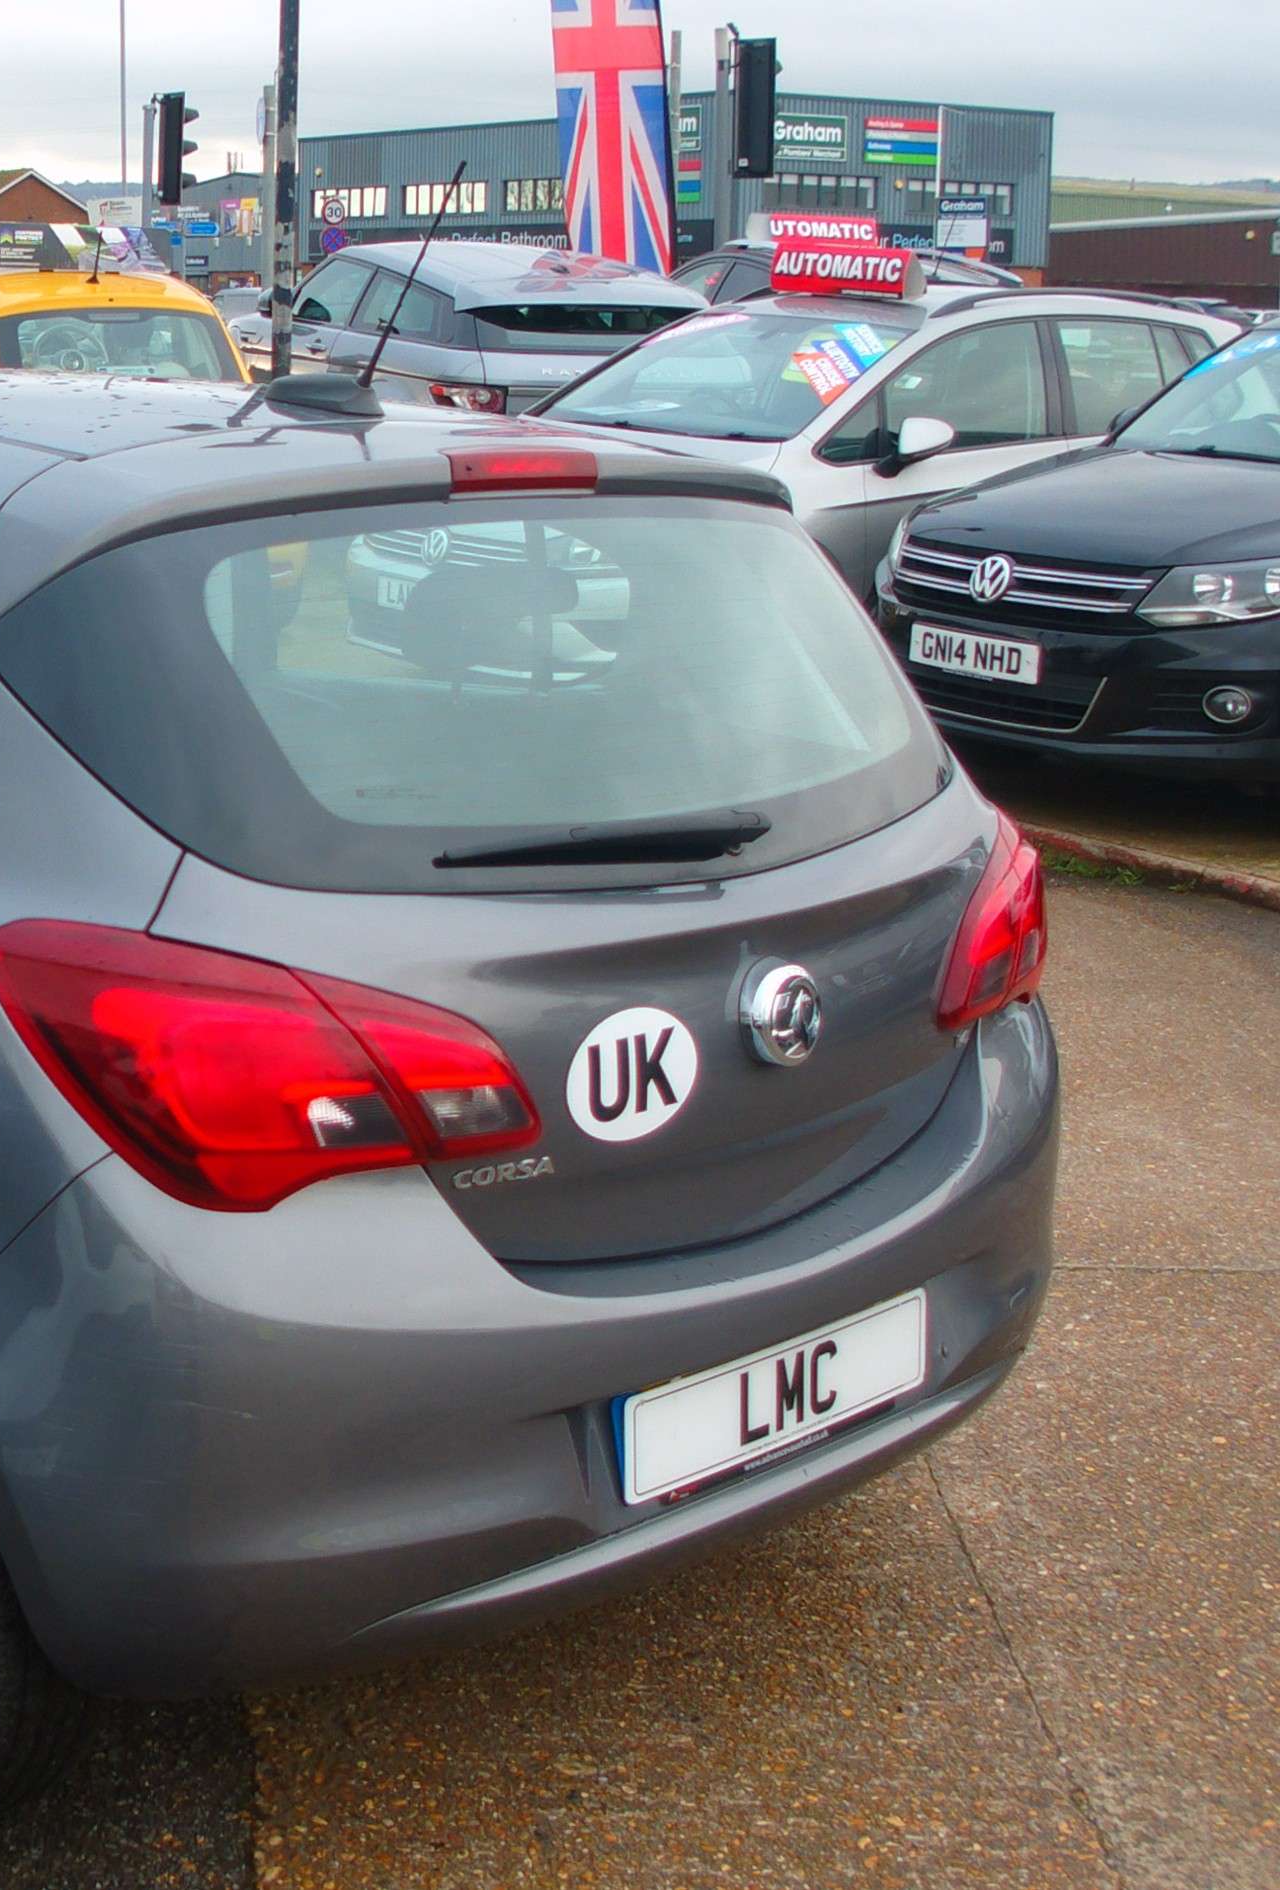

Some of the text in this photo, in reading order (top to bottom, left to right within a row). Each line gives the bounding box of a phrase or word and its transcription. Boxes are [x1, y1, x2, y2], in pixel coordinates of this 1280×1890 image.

[774, 119, 842, 142] Graham
[326, 206, 341, 217] 30
[941, 200, 984, 212] Graham
[501, 231, 567, 248] Bathroom
[770, 219, 873, 240] UTOMATIC
[774, 250, 903, 283] AUTOMATIC
[921, 632, 1023, 676] GN14 NHD
[587, 1026, 679, 1123] UK
[452, 1156, 554, 1190] CORSA
[740, 1339, 838, 1446] LMC
